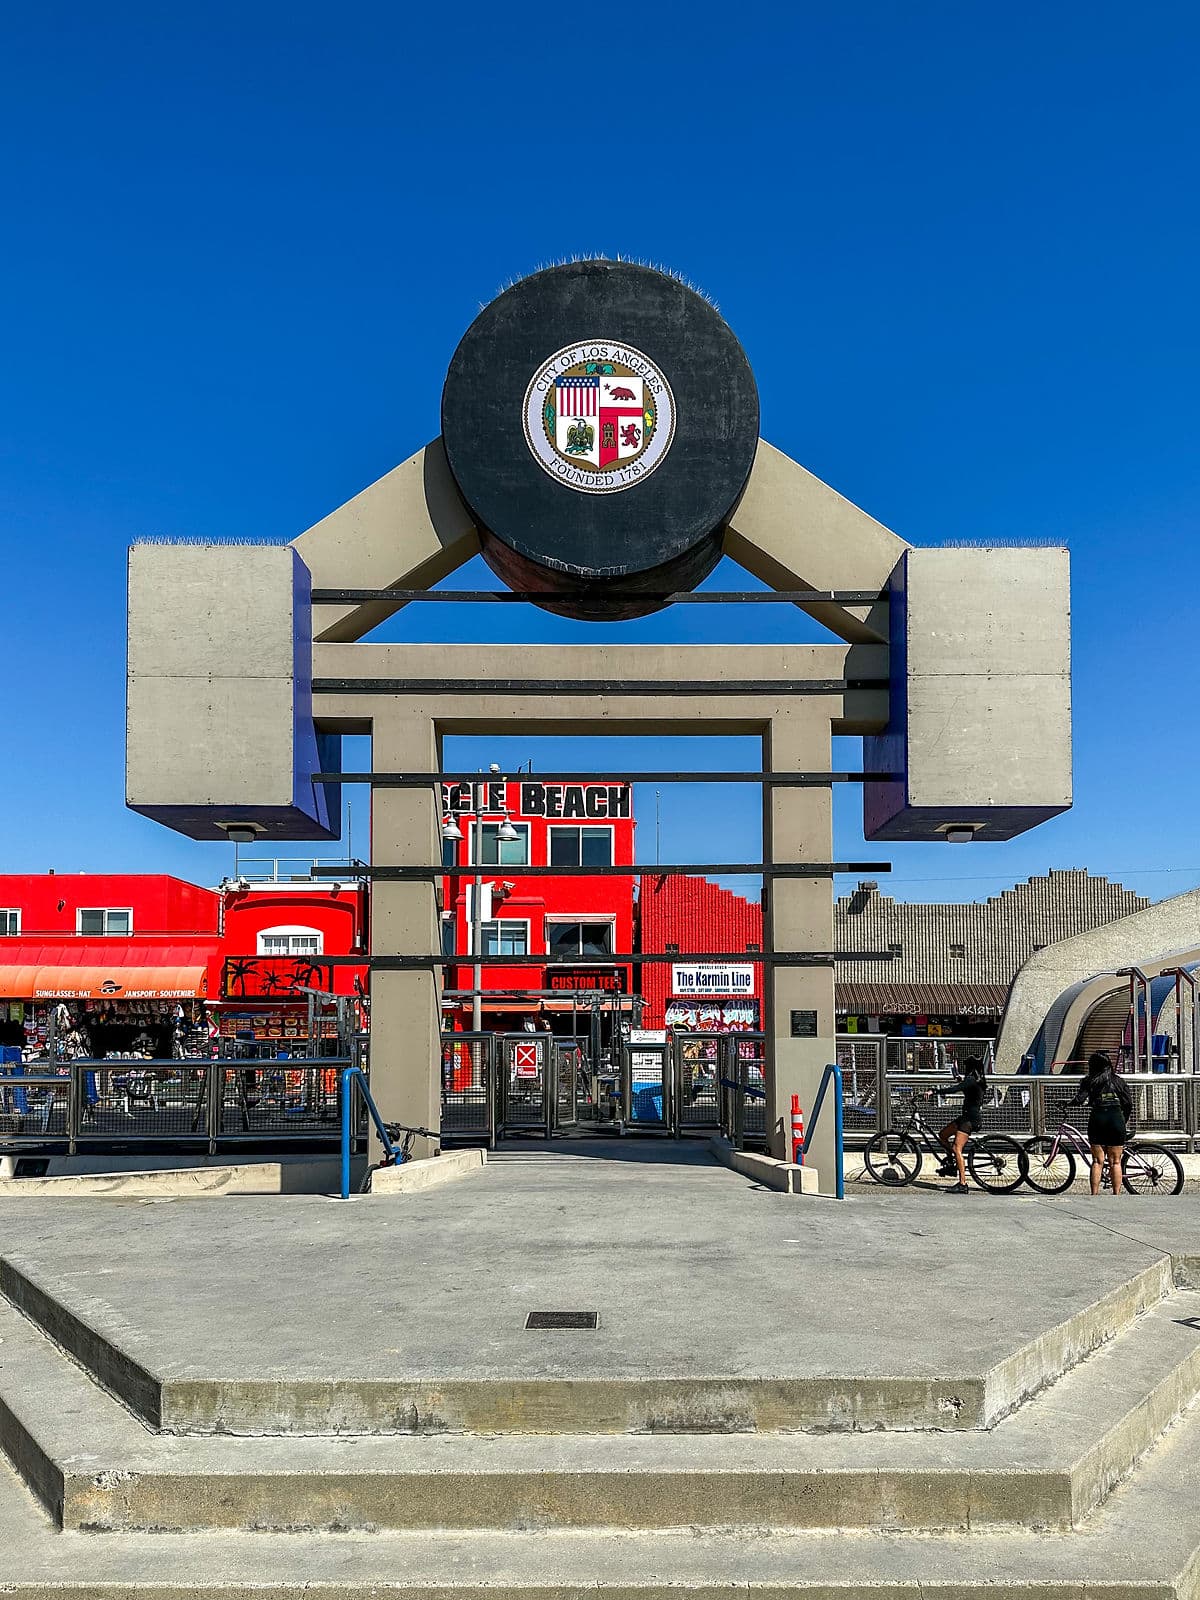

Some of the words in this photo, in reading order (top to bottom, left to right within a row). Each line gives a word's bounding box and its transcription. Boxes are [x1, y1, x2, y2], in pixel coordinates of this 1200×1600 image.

[536, 366, 561, 392] CITY
[560, 351, 578, 367] OF
[582, 347, 609, 359] LOS
[612, 350, 663, 395] ANGELES
[550, 458, 614, 486] FOUNDED
[620, 462, 647, 482] 1781
[521, 783, 631, 818] BEACH
[551, 976, 596, 989] CUSTOM
[676, 971, 694, 987] The
[695, 971, 730, 987] Karmin
[731, 971, 751, 987] Line
